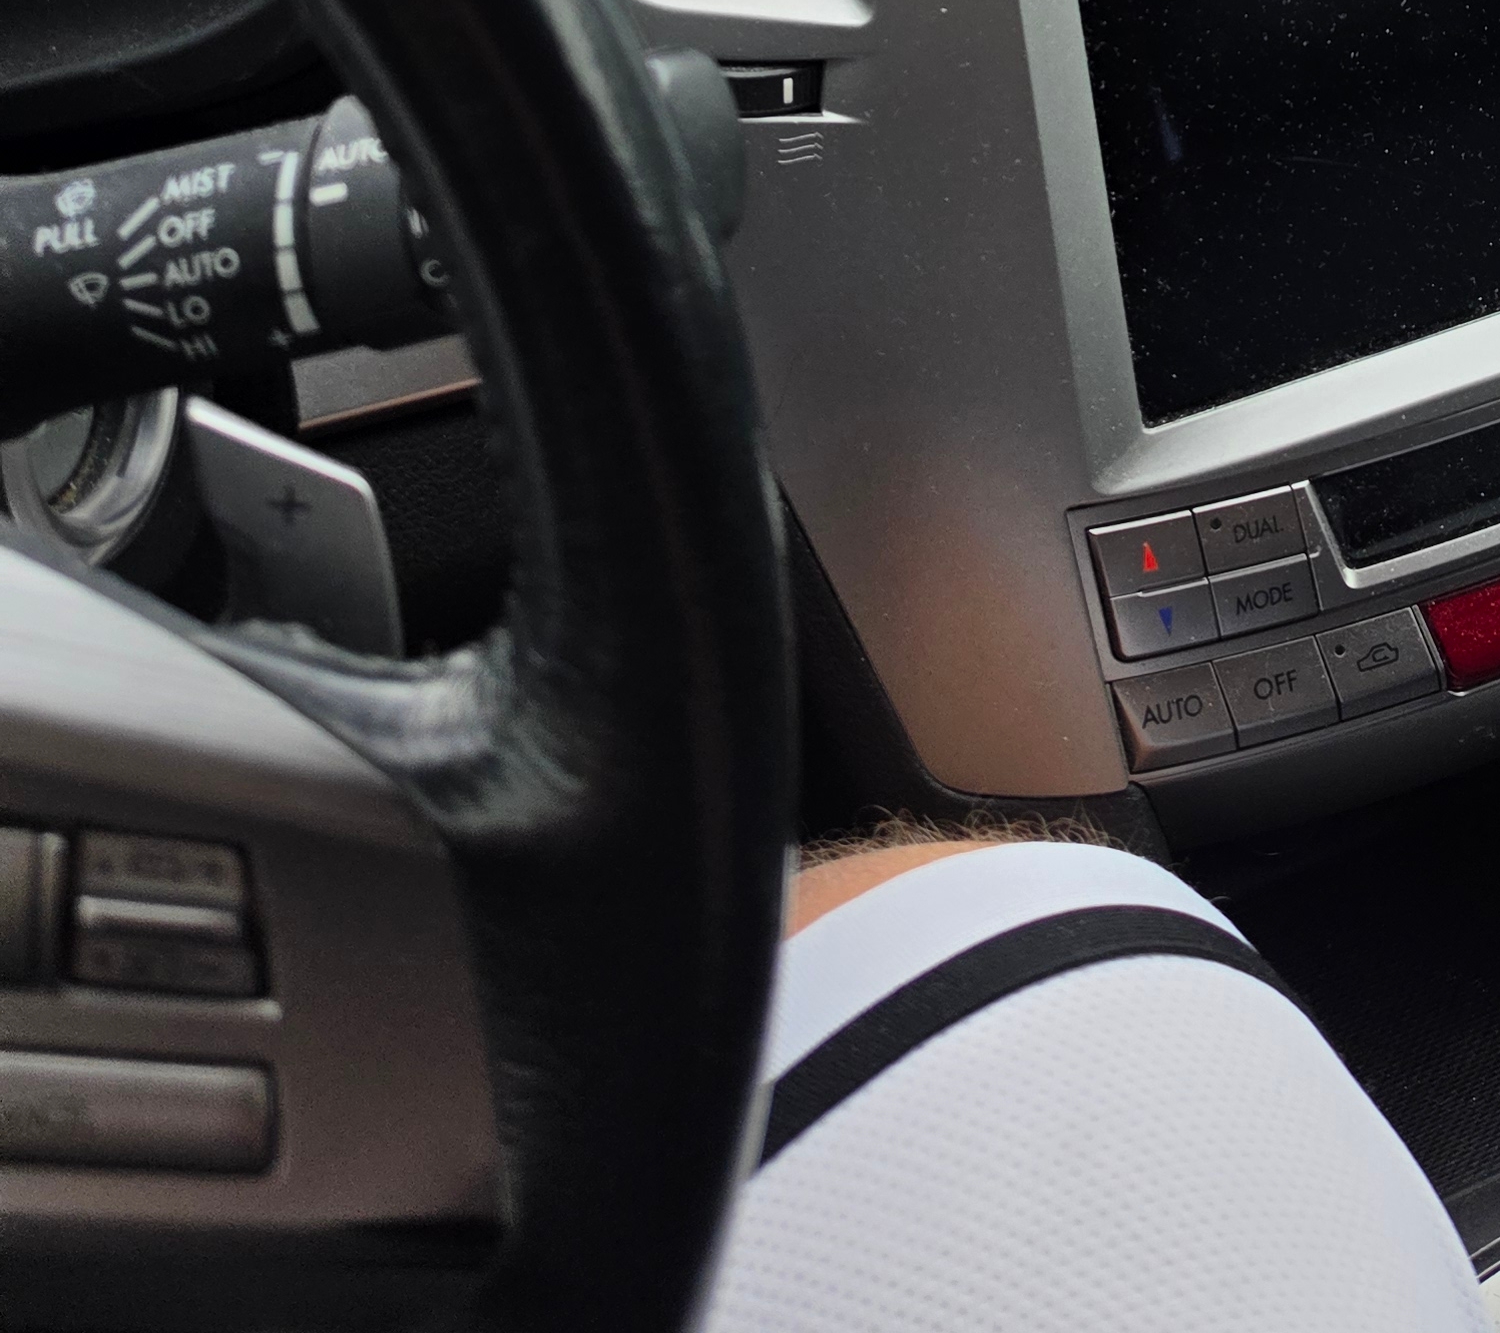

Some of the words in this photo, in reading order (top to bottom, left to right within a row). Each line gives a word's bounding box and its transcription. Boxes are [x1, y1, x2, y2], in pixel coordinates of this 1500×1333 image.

[161, 163, 235, 204] MIST
[34, 217, 99, 257] PULL
[157, 208, 216, 248] OFF
[164, 247, 240, 289] AUTO
[167, 295, 210, 328] LO
[1233, 515, 1284, 543] DUAL
[1236, 583, 1294, 615] MODE
[1253, 669, 1298, 700] OFF
[1142, 694, 1203, 729] AUTO
